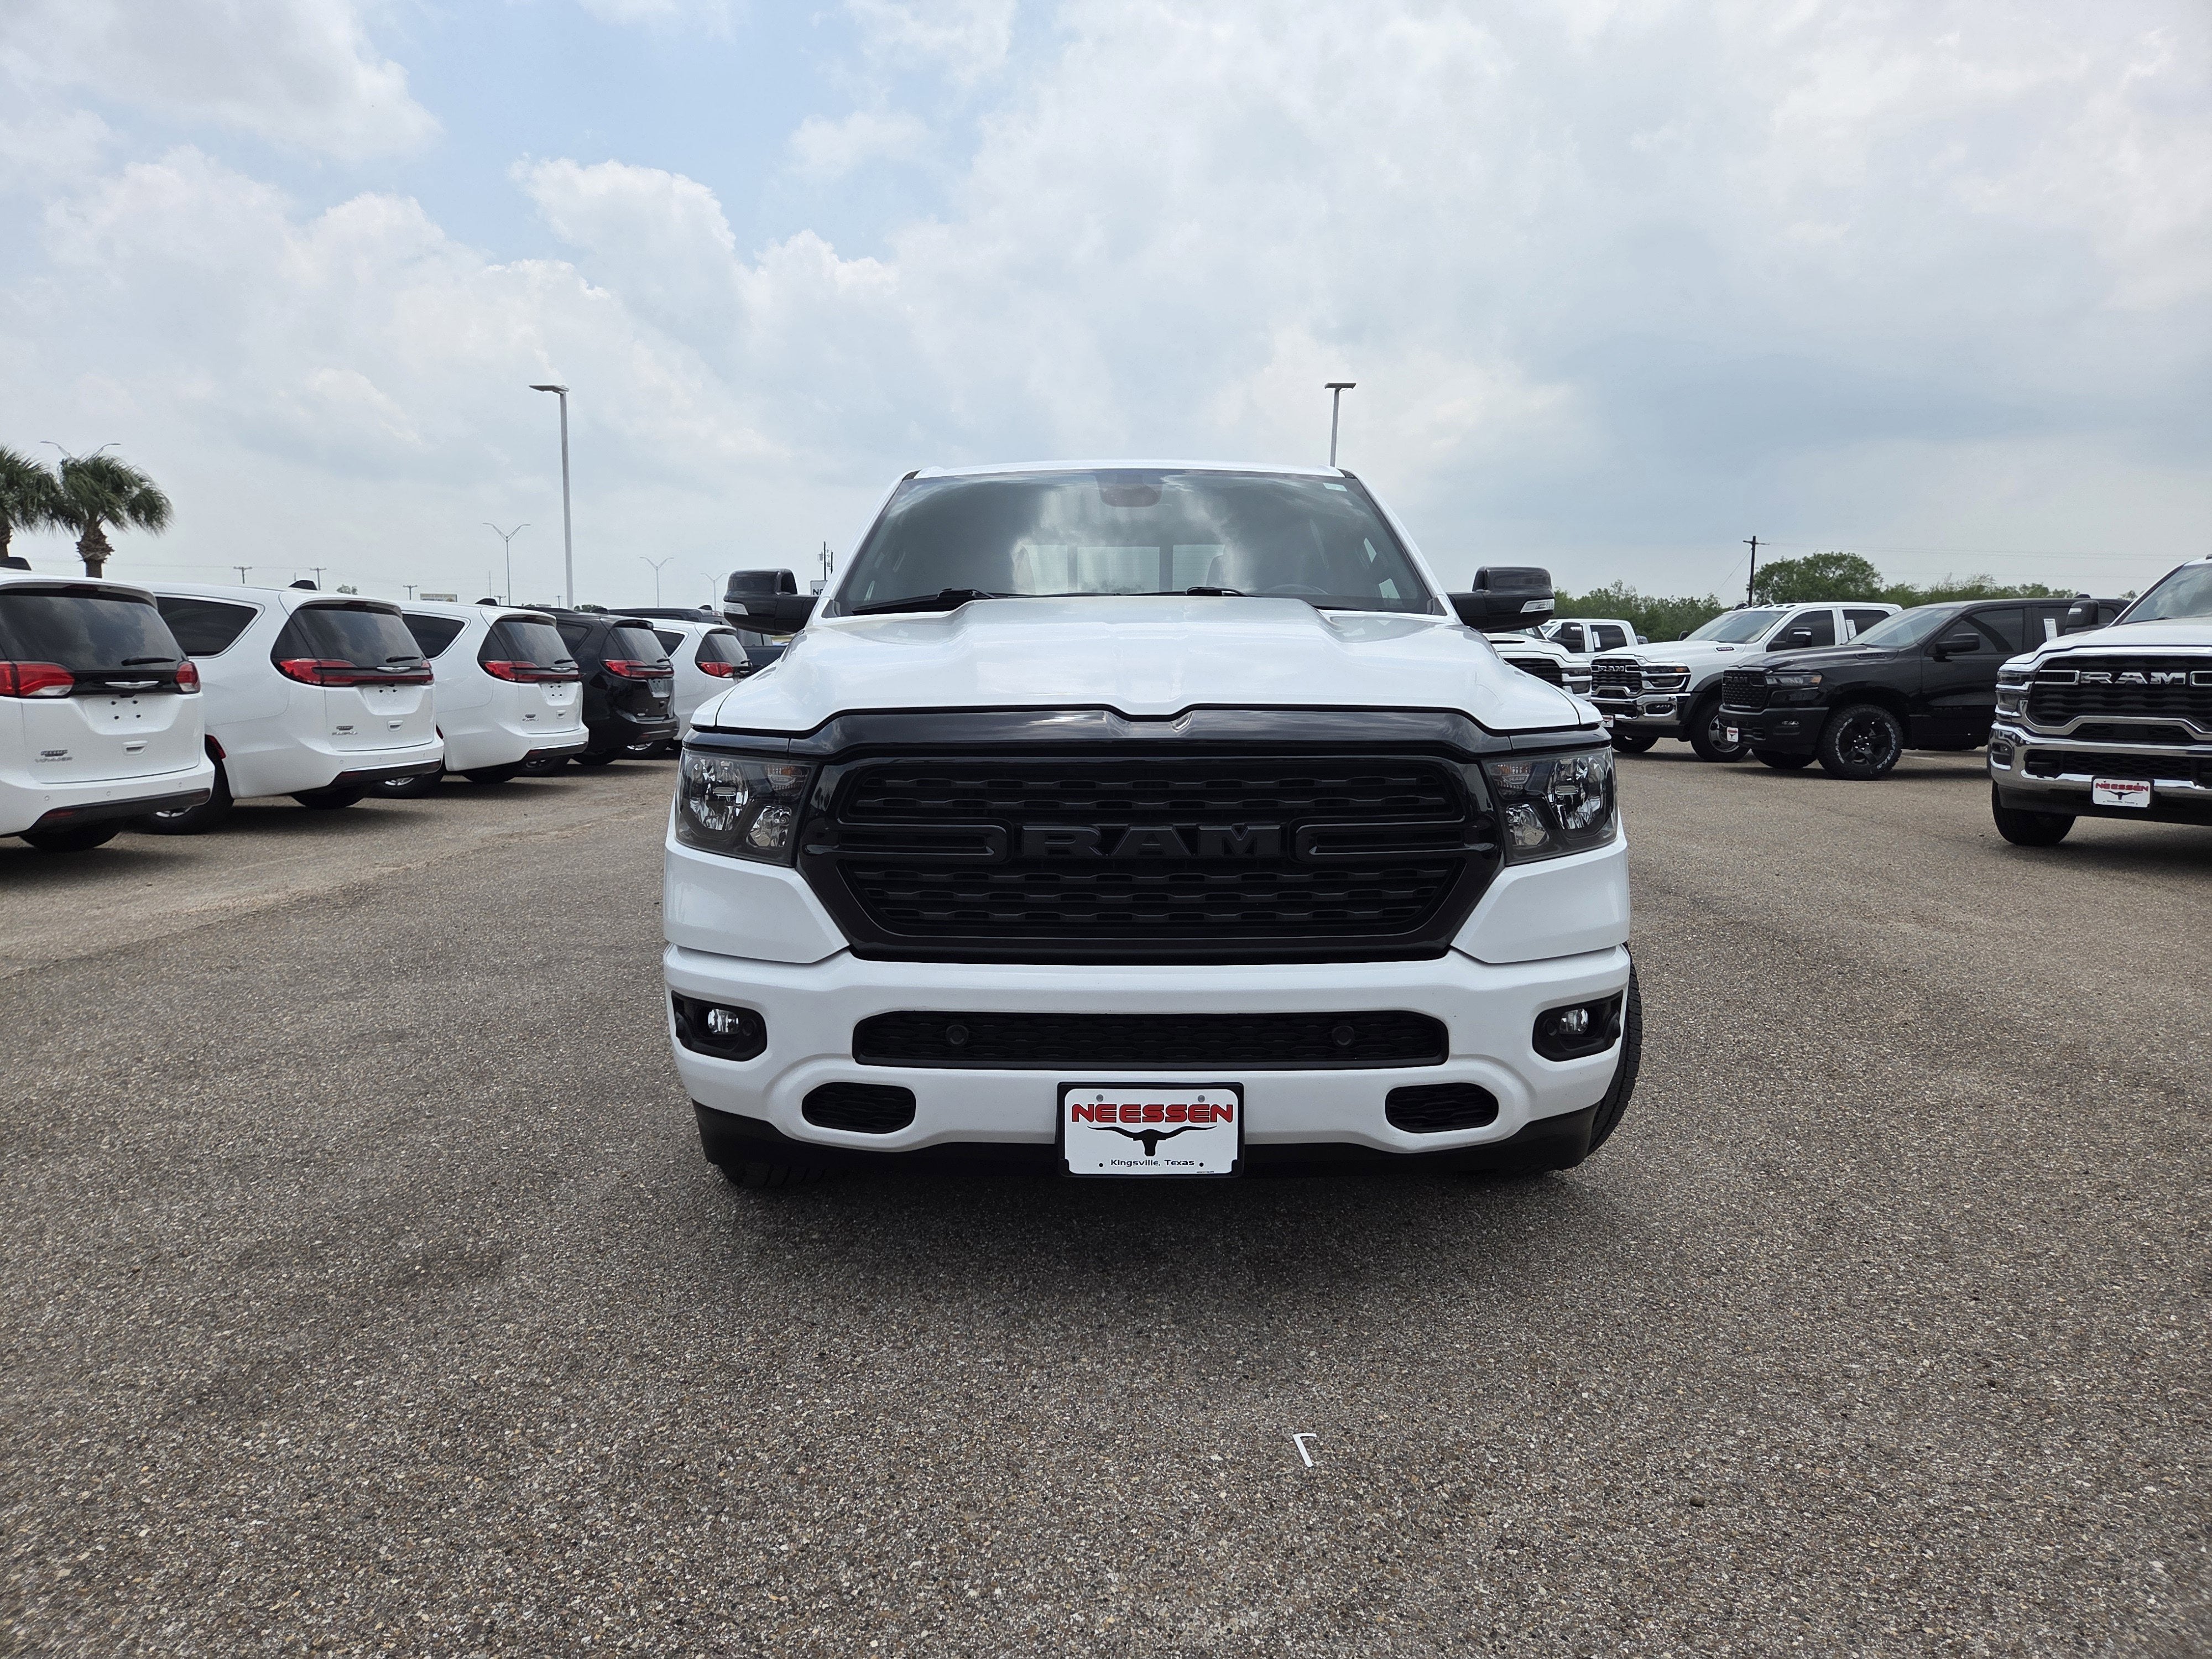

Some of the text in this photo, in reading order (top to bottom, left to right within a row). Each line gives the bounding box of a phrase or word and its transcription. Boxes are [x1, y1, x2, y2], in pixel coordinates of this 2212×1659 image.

[2080, 671, 2187, 685] RAM
[2095, 782, 2149, 792] NEESSEN
[1022, 825, 1282, 856] RAM
[1071, 1103, 1234, 1123] NEESSEN
